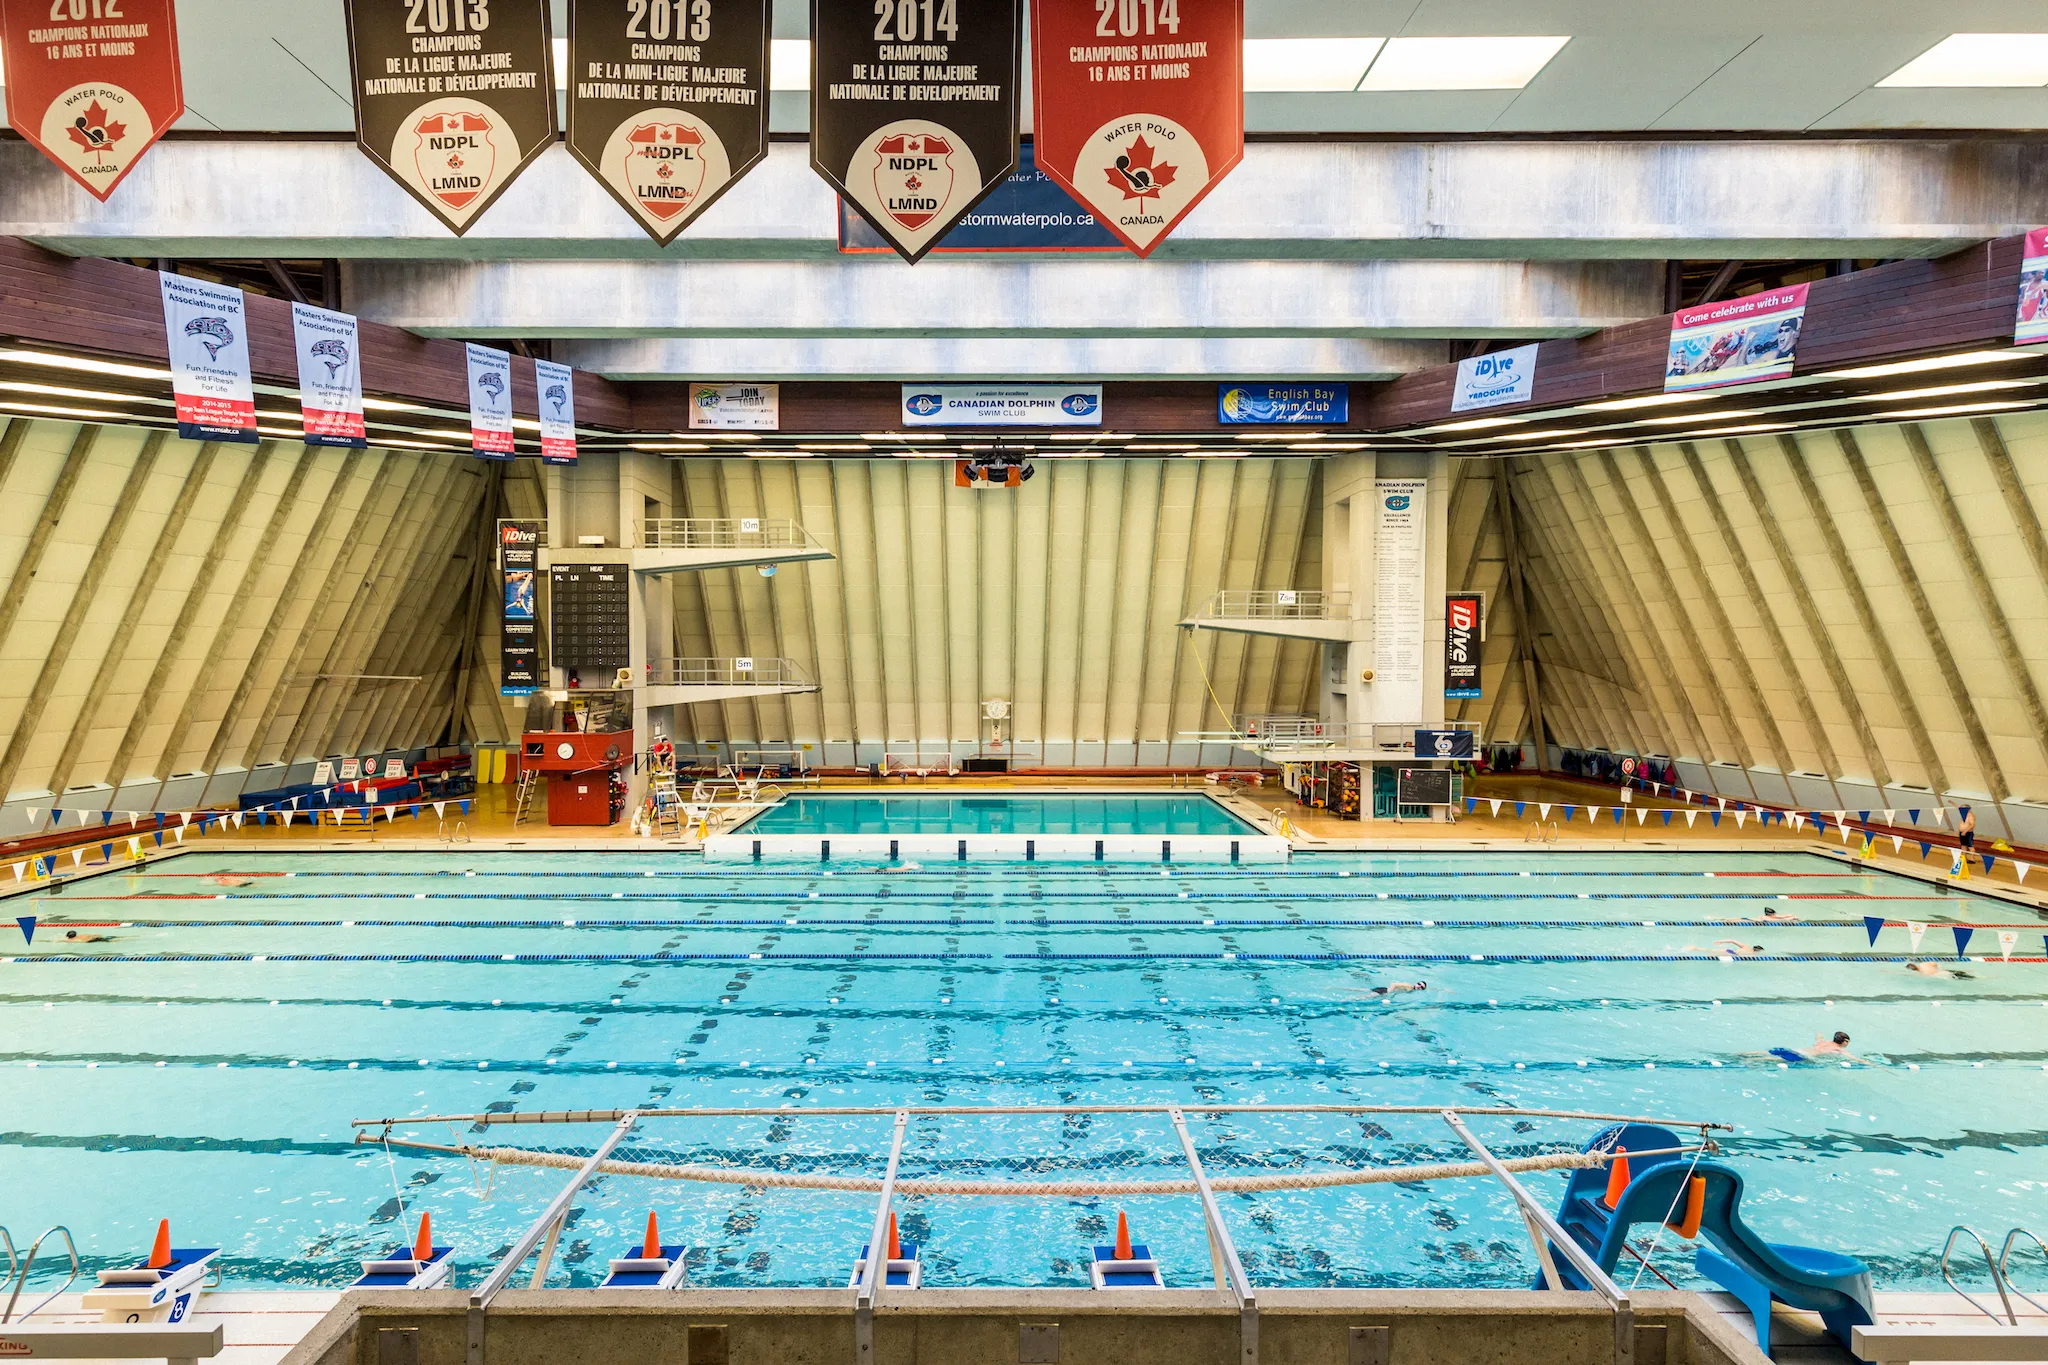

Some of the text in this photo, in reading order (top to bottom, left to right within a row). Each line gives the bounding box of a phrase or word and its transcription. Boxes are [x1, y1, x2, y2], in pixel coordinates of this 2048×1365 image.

[405, 0, 490, 33] 2013
[626, 0, 711, 41] 2013
[874, 0, 958, 41] 2014
[1096, 0, 1180, 37] 2014
[29, 24, 148, 43] CHAMPIONS NATIONAUX
[46, 42, 135, 59] 16 ANS ET MOINS
[412, 35, 481, 53] CHAMPIONS
[632, 43, 700, 62] CHAMPIONS
[1070, 42, 1207, 62] CHAMPIONS NATIONAUX
[879, 46, 948, 61] CHAMPIONS
[386, 53, 512, 73] DE LA LIGUE MAJEURE
[589, 62, 746, 84] DE LA MINI-LIGUE MAJEURE
[853, 65, 977, 80] DE LA LIGUE MAJEURE
[1089, 63, 1189, 81] 16 ANS ET MOINS
[366, 72, 536, 95] NATIONALE DE DÉVELOPPEMENT
[65, 90, 124, 106] WATER POLO
[579, 83, 756, 105] NATIONALE DE DÉVELOPPEMENT
[830, 84, 1000, 101] NATIONALE DE DEVELOPPEMENT
[1104, 122, 1176, 143] WATER POLO
[430, 136, 478, 149] NDPL
[646, 147, 693, 160] NDPL
[82, 166, 118, 174] CANADA
[890, 158, 937, 170] NDPL
[433, 176, 480, 189] LMND
[1007, 172, 1031, 182] ater
[638, 185, 686, 198] LMND
[889, 198, 937, 209] LMND
[1120, 216, 1164, 225] CANADA
[164, 281, 240, 305] Masters Swimming
[169, 294, 216, 309] Association
[1683, 294, 1793, 324] Come celebrate with us
[295, 308, 354, 328] Masters Swimming
[299, 319, 335, 333] Association
[741, 388, 758, 397] JOIN
[1269, 389, 1334, 401] English Bay
[1469, 386, 1515, 399] VANCOUVER
[740, 397, 764, 407] TODAY
[1272, 401, 1329, 411] Swim Club
[505, 531, 536, 540] iDive
[1453, 605, 1471, 663] iDive
[174, 1301, 183, 1319] 8
